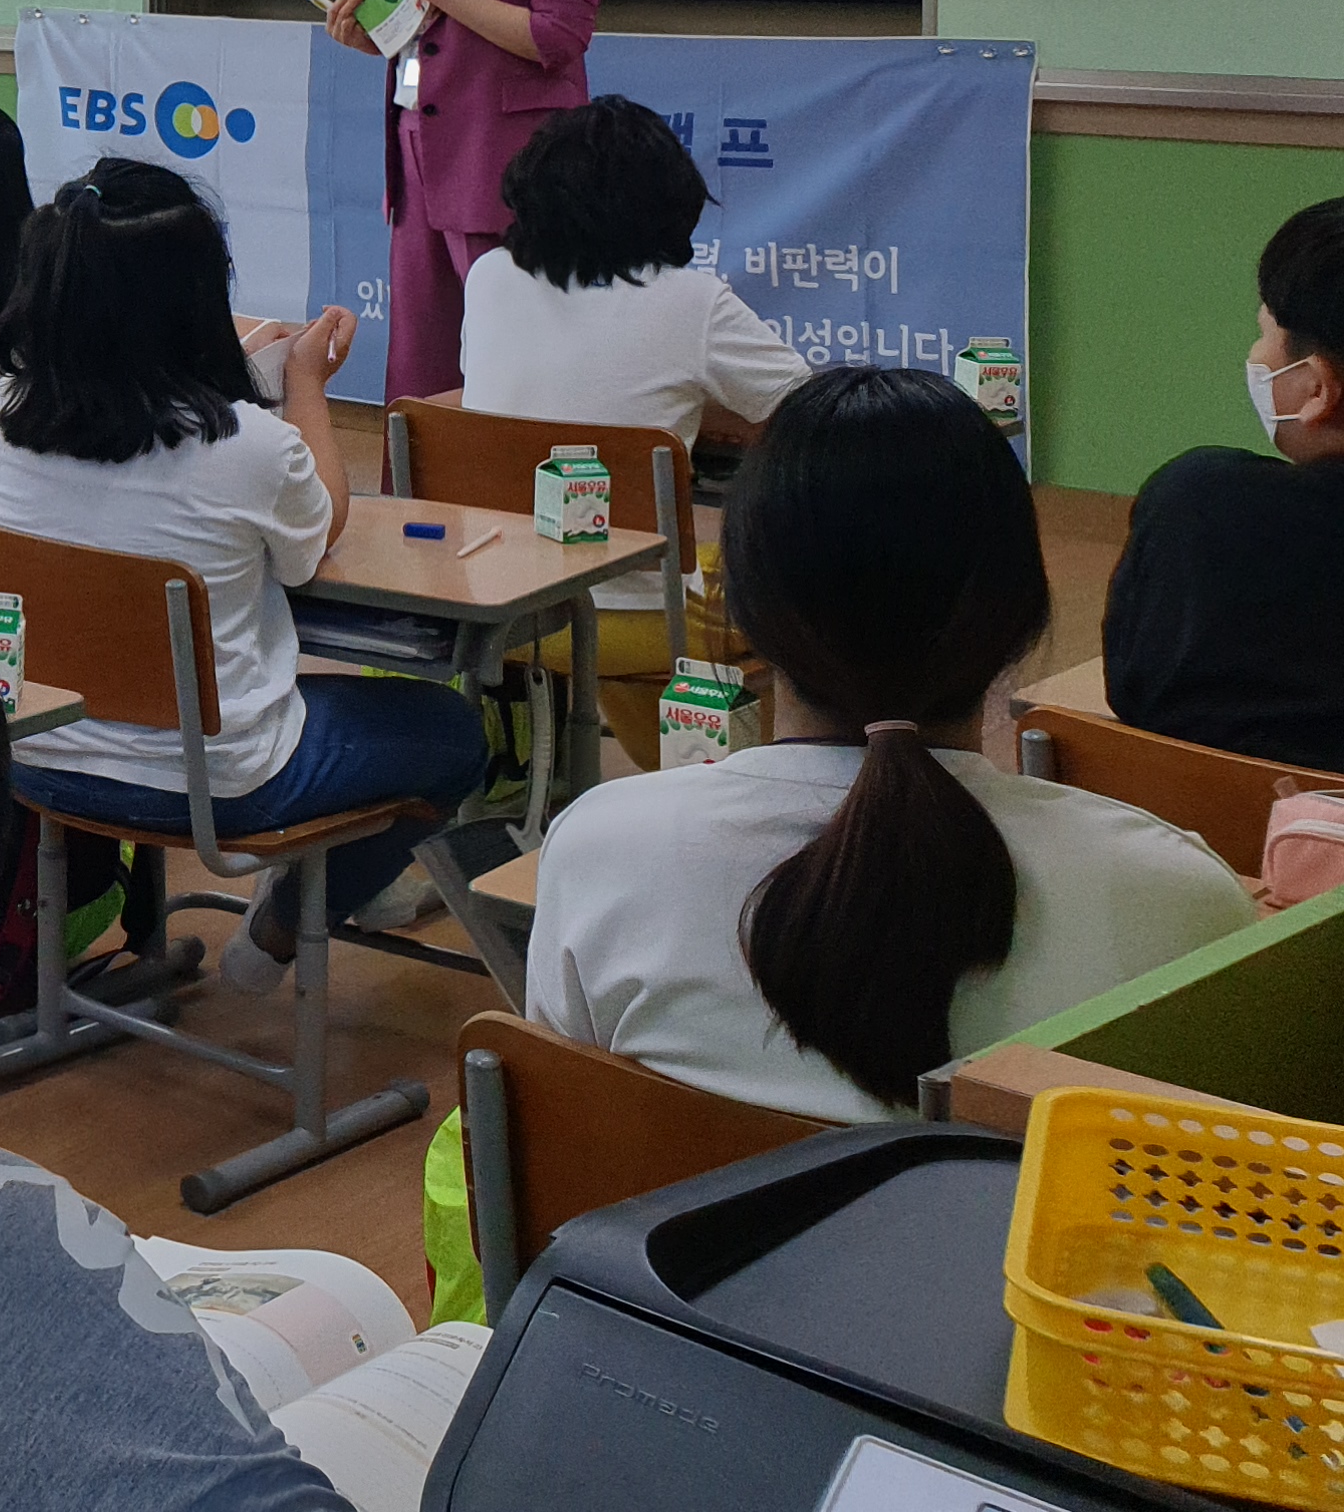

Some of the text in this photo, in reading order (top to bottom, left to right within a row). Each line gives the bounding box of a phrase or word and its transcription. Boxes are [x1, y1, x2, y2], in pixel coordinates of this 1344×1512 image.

[59, 86, 147, 136] EBS
[744, 241, 899, 294] 비판력이
[357, 276, 391, 320] 있
[666, 706, 722, 730] 서울우유
